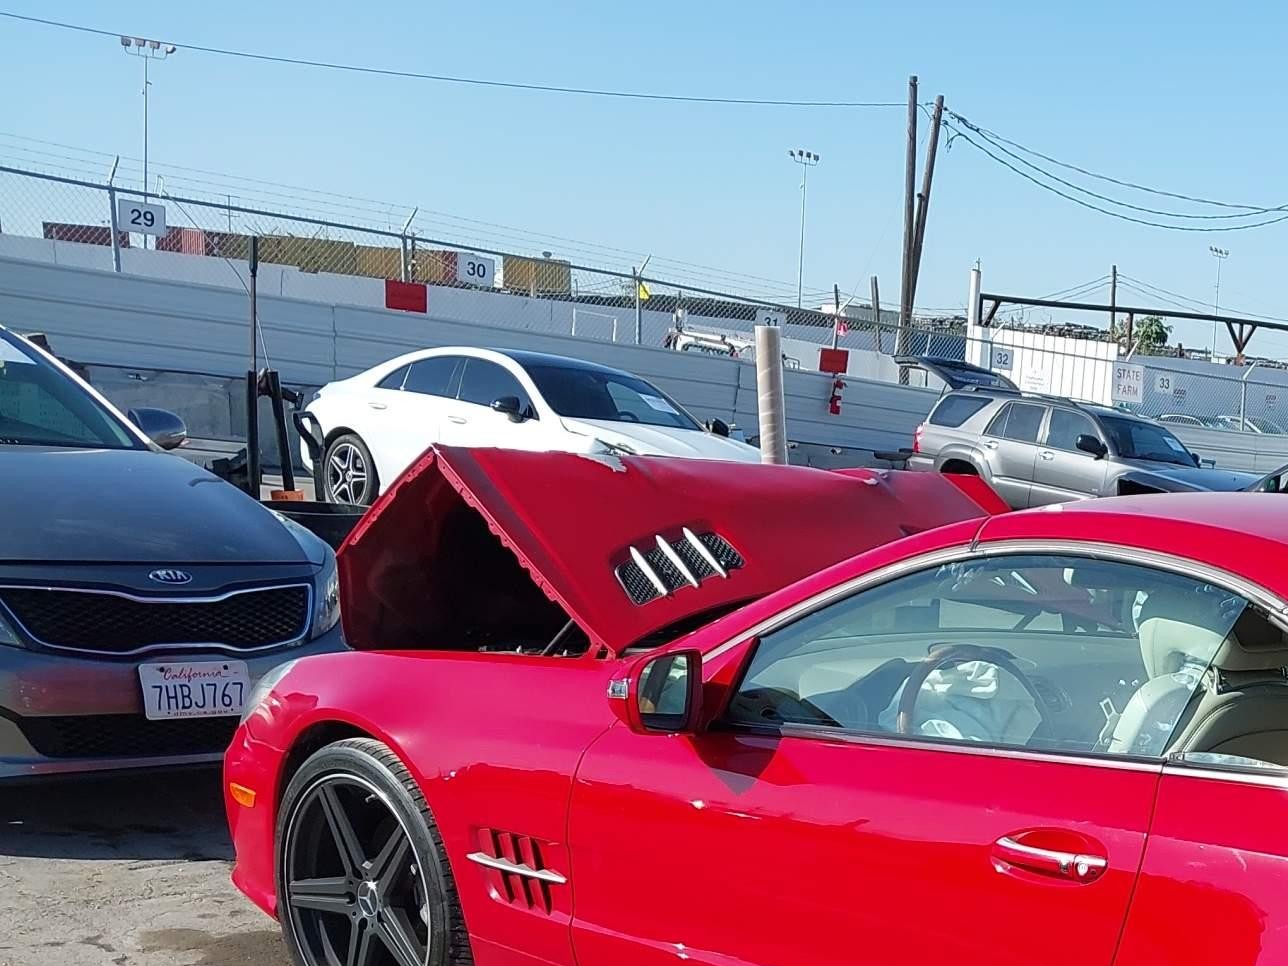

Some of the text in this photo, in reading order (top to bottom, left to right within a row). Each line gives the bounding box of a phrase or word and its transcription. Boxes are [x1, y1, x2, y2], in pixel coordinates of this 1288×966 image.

[131, 209, 154, 227] 29
[467, 261, 486, 278] 30
[996, 352, 1009, 365] 32
[1117, 368, 1140, 381] STATE
[1117, 383, 1138, 396] FARM
[1160, 377, 1170, 389] 33
[163, 667, 224, 683] California
[152, 682, 243, 711] 7HBJ767
